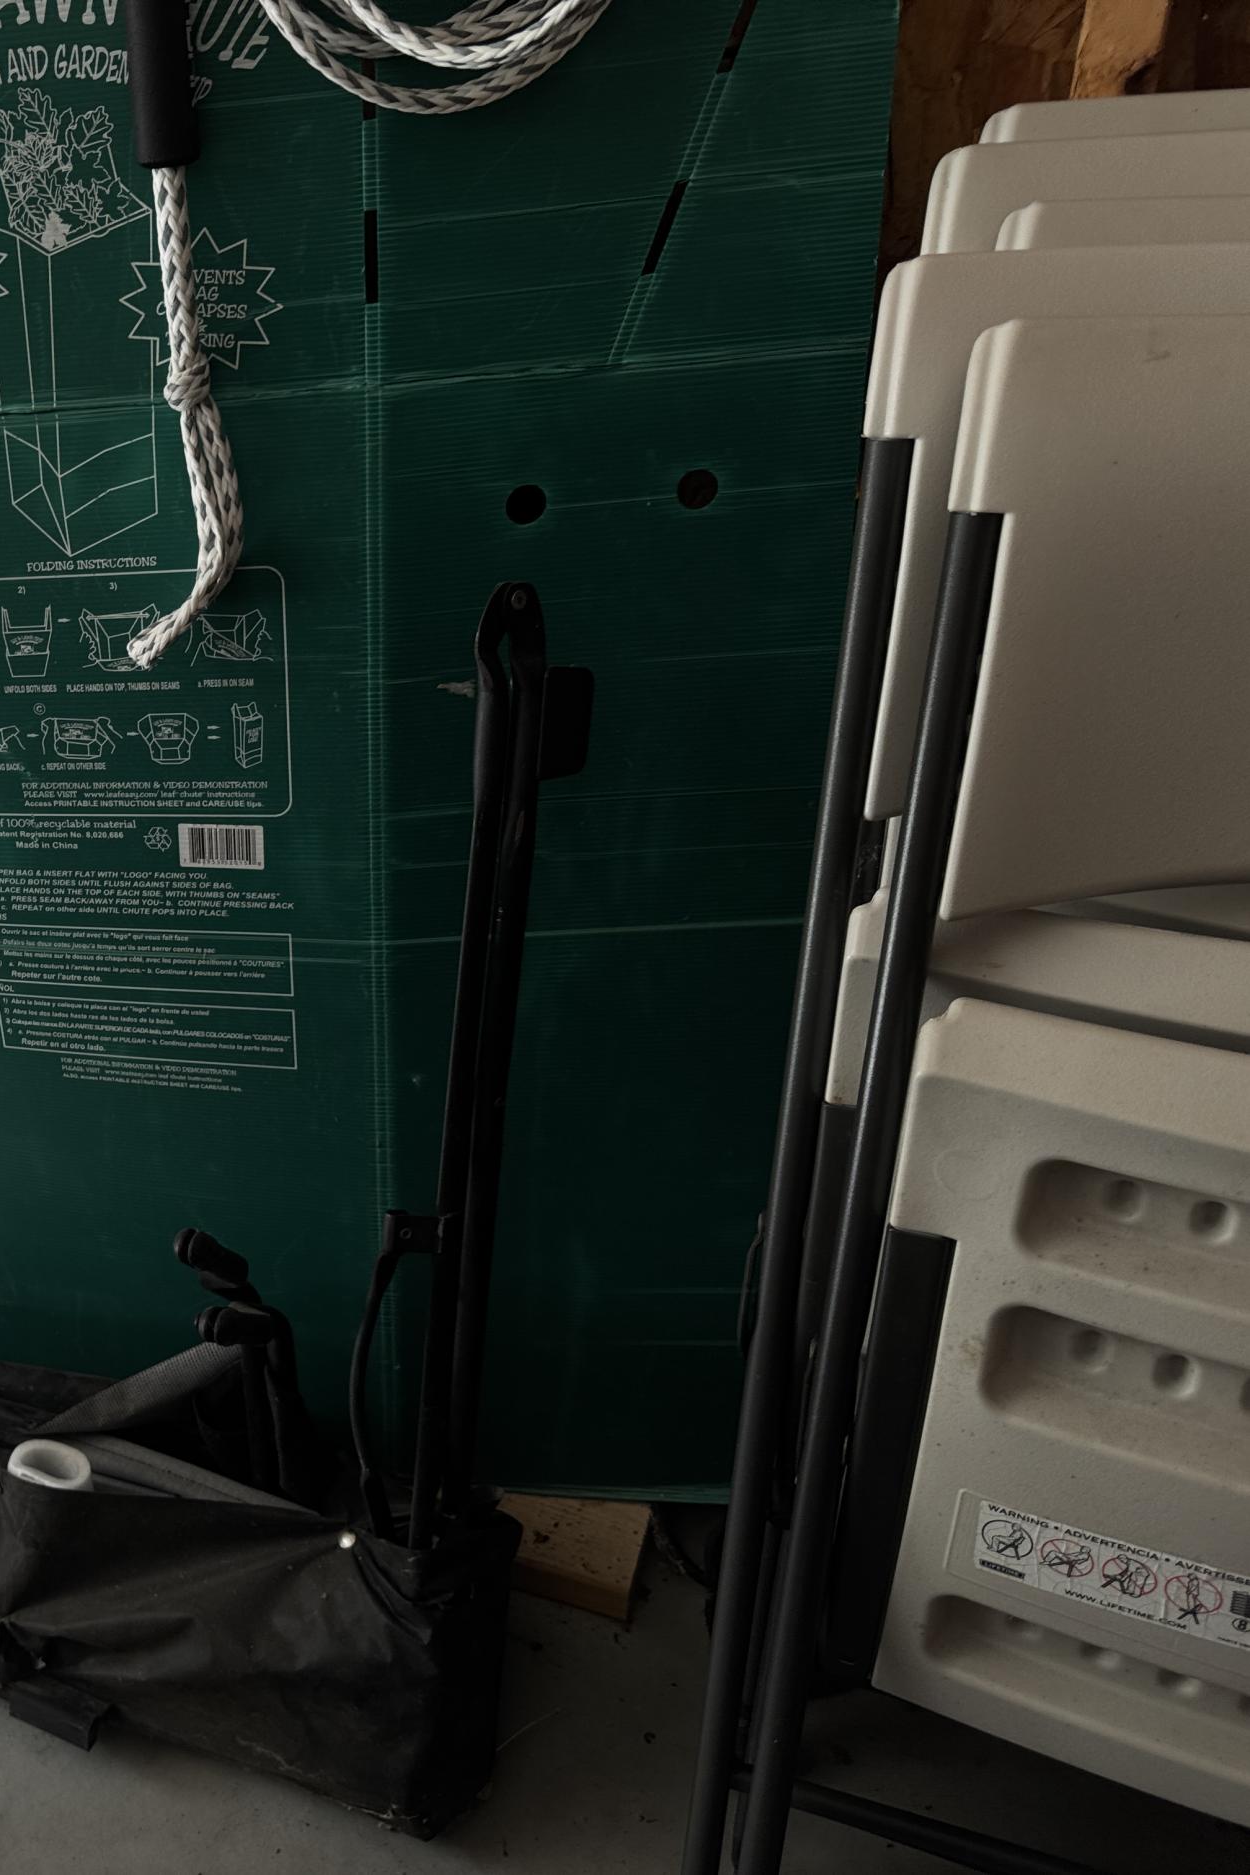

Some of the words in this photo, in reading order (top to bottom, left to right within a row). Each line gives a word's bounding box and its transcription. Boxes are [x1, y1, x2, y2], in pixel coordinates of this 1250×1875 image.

[7, 45, 49, 84] AND
[194, 286, 219, 300] AG
[26, 560, 74, 572] FOLDING
[76, 556, 157, 569] INSTRUCTIONS
[17, 585, 26, 595] 2)
[109, 581, 117, 591] 3)
[65, 683, 84, 692] PLACE
[85, 683, 104, 691] HANDS
[104, 682, 113, 691] ON
[127, 681, 150, 690] THUMBS
[151, 681, 160, 690] ON
[160, 681, 180, 689] SEAMS
[203, 679, 222, 687] PRESS
[222, 678, 229, 687] IN
[229, 678, 237, 687] ON
[238, 678, 254, 687] SEAM
[46, 762, 66, 770] REPEAT
[66, 762, 75, 770] ON
[75, 762, 93, 770] OTHER
[93, 762, 106, 770] SIDE
[152, 781, 161, 789] &
[162, 781, 190, 789] VIDEO
[6, 819, 36, 827] 100%
[38, 819, 91, 830] recyclable
[92, 819, 136, 828] material
[19, 830, 68, 839] Registration
[41, 841, 50, 849] in
[43, 869, 72, 877] INSERT
[96, 870, 118, 878] WITH
[153, 871, 186, 879] FACING
[27, 878, 50, 886] BOTH
[77, 879, 102, 887] UNTIL
[132, 880, 169, 888] AGAINST
[171, 881, 196, 889] SIDES
[52, 887, 65, 895] ON
[103, 888, 114, 896] OF
[188, 890, 225, 898] THUMBS
[10, 895, 37, 903] PRESS
[63, 897, 114, 905] BACK/AWAY
[177, 900, 221, 908] CONTINUE
[222, 901, 267, 909] PRESSING
[268, 902, 294, 910] BACK
[11, 904, 43, 912] REPEAT
[56, 905, 76, 913] other
[96, 906, 120, 914] UNTIL
[121, 907, 150, 915] CHUTE
[152, 908, 174, 916] POPS
[42, 972, 55, 980] sur
[60, 1041, 68, 1049] el
[69, 1041, 85, 1050] otro
[988, 1504, 1049, 1529] WARNING
[1065, 1528, 1159, 1560] ADVERTENCIA
[1064, 1588, 1187, 1630] WWW.LIFETIME.COM
